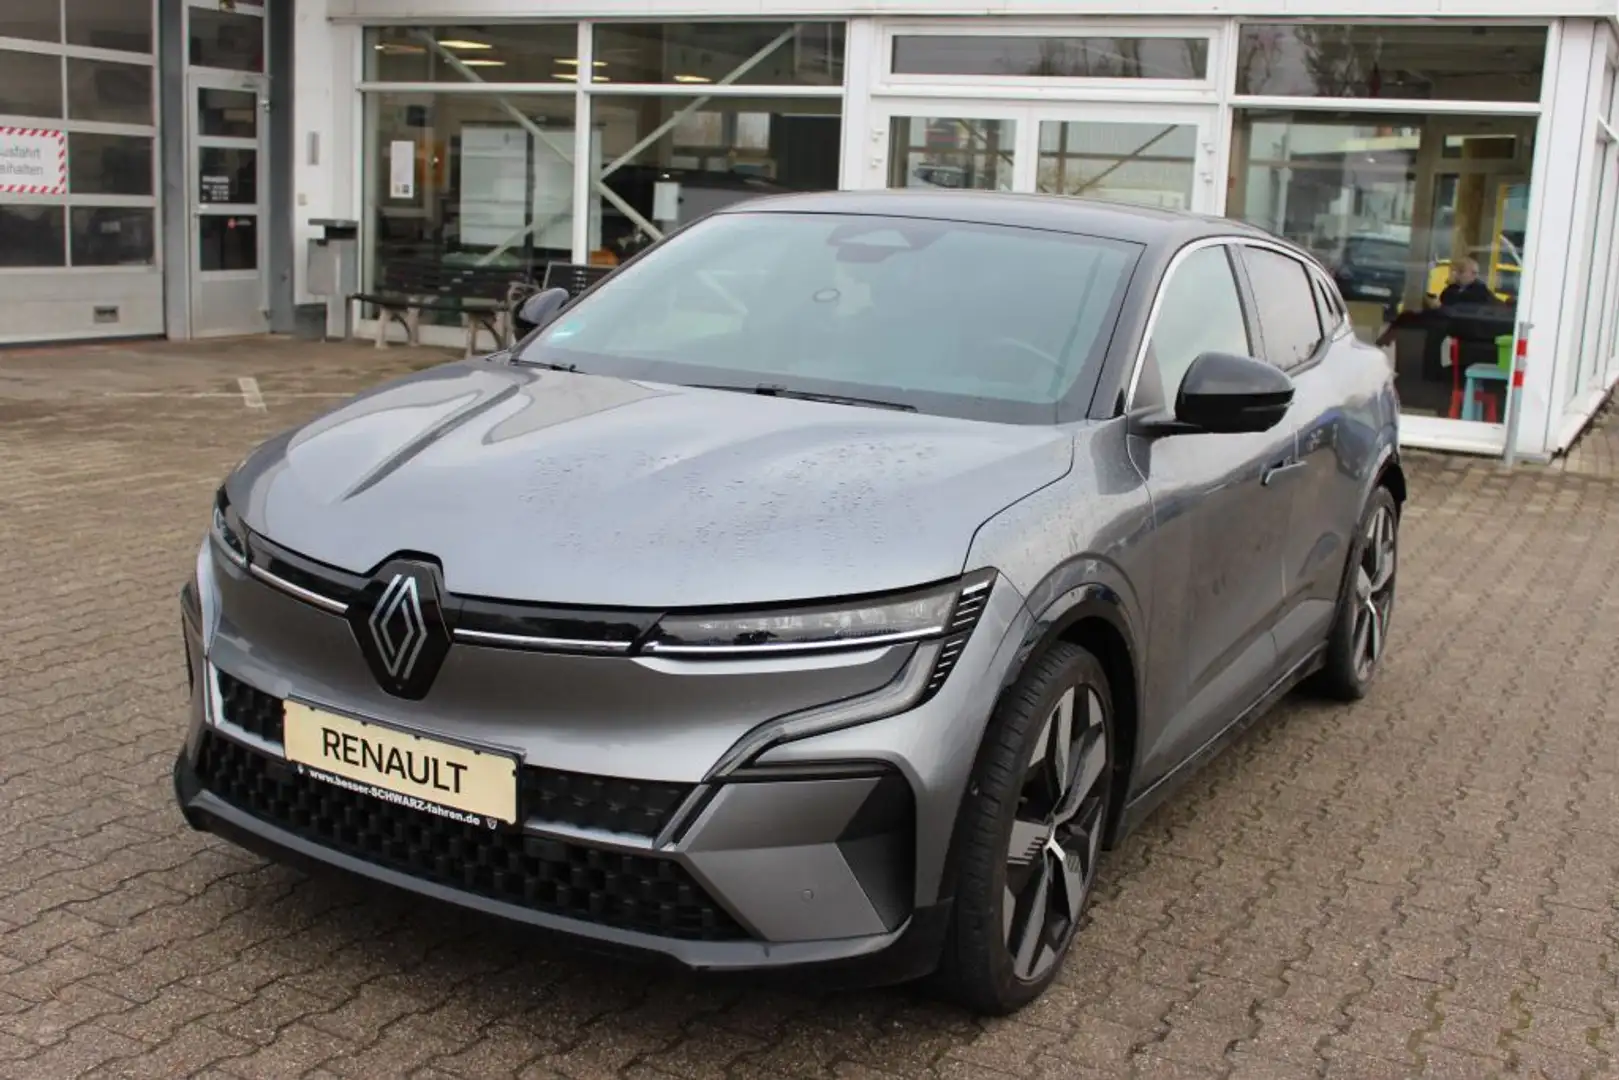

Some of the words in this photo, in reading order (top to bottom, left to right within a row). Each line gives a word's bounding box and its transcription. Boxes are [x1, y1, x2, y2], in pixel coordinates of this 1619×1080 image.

[0, 145, 41, 158] usfahrt
[322, 727, 468, 793] RENAULT
[309, 769, 480, 827] www.besser-SCHWARZ-fahren.de
